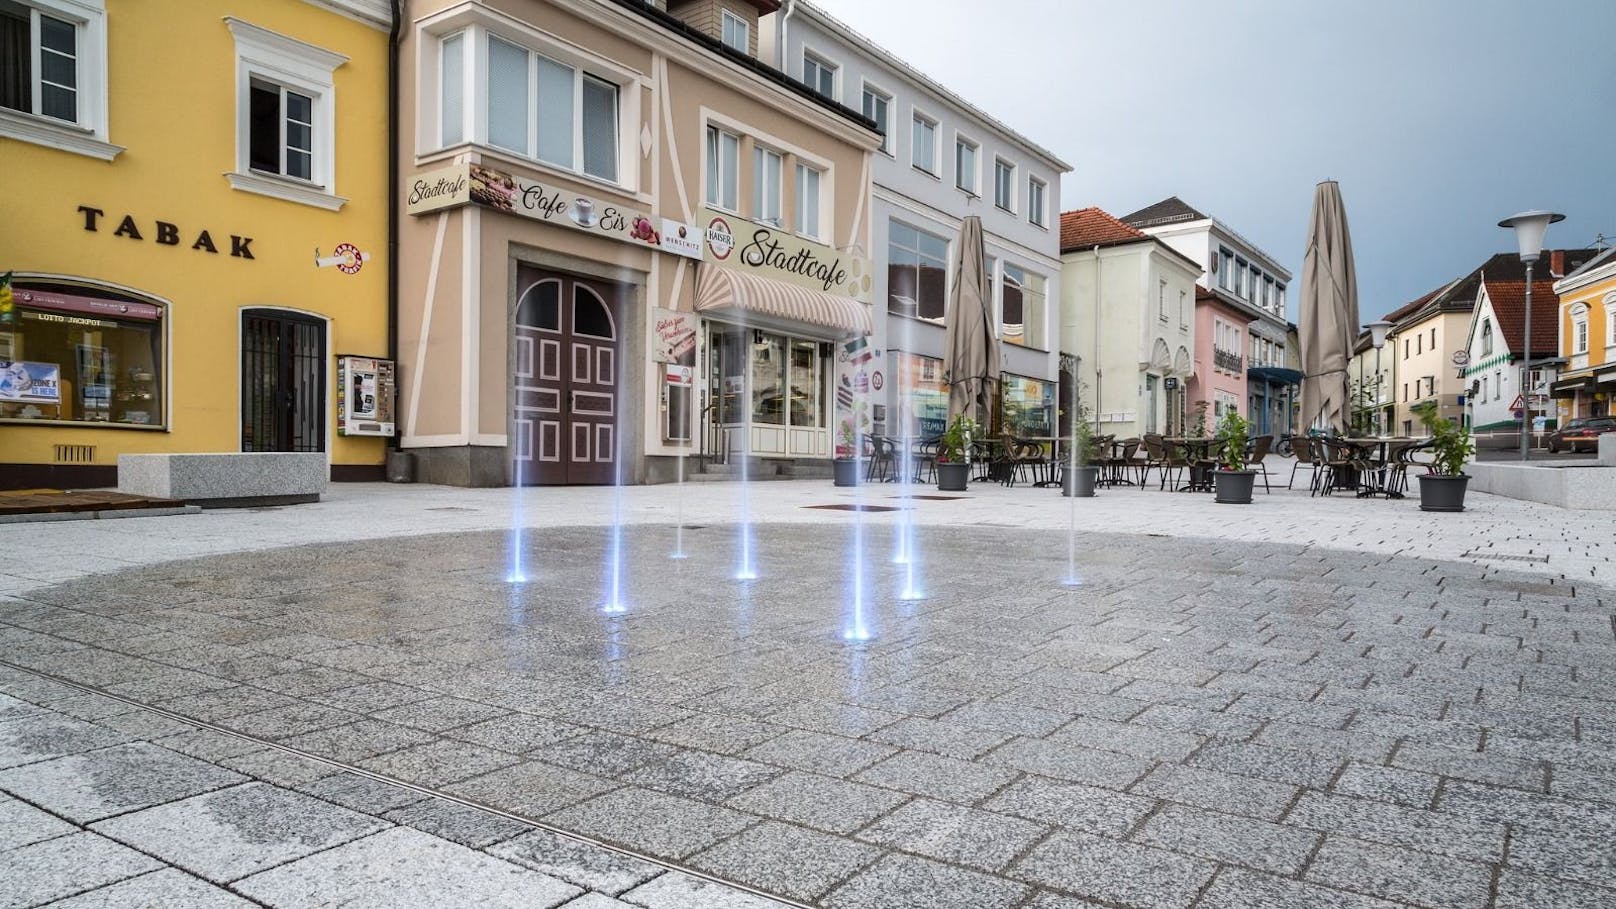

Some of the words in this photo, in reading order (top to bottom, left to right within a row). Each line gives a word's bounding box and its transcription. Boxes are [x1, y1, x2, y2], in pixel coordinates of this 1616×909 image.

[408, 177, 466, 206] Stadtcafe
[518, 183, 568, 219] Cafe
[599, 206, 628, 231] Eis
[77, 205, 256, 260] TABAK
[708, 230, 732, 245] KAISER
[740, 229, 847, 291] Stadtcafe
[38, 313, 64, 322] LOTTO
[68, 316, 101, 326] JACKPOT
